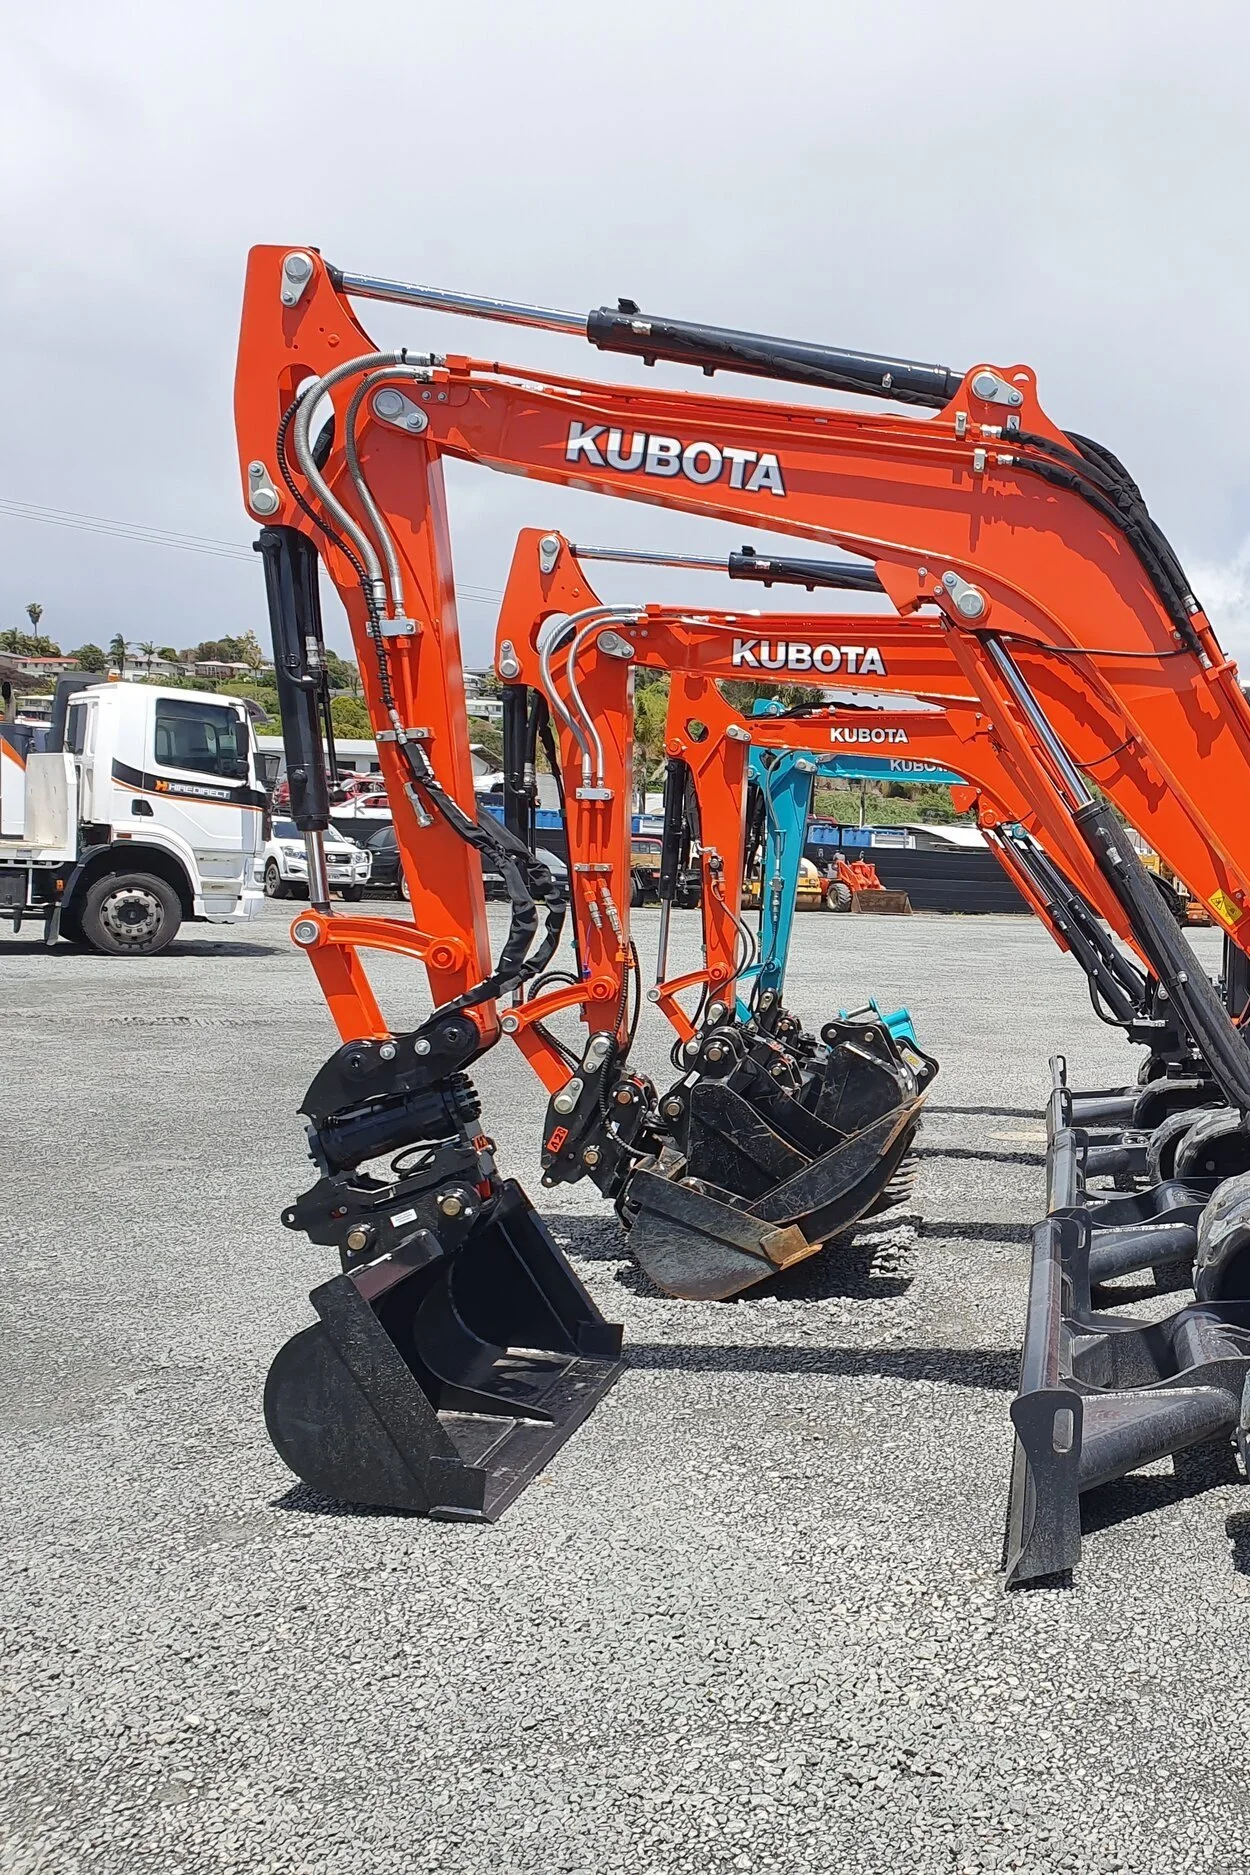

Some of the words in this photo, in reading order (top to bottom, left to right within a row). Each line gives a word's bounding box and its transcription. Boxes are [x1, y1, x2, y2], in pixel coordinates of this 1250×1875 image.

[565, 420, 786, 496] KUBOTA
[732, 638, 887, 676] KUBOTA
[829, 727, 909, 744] KUBOTA
[890, 759, 948, 772] KUBO
